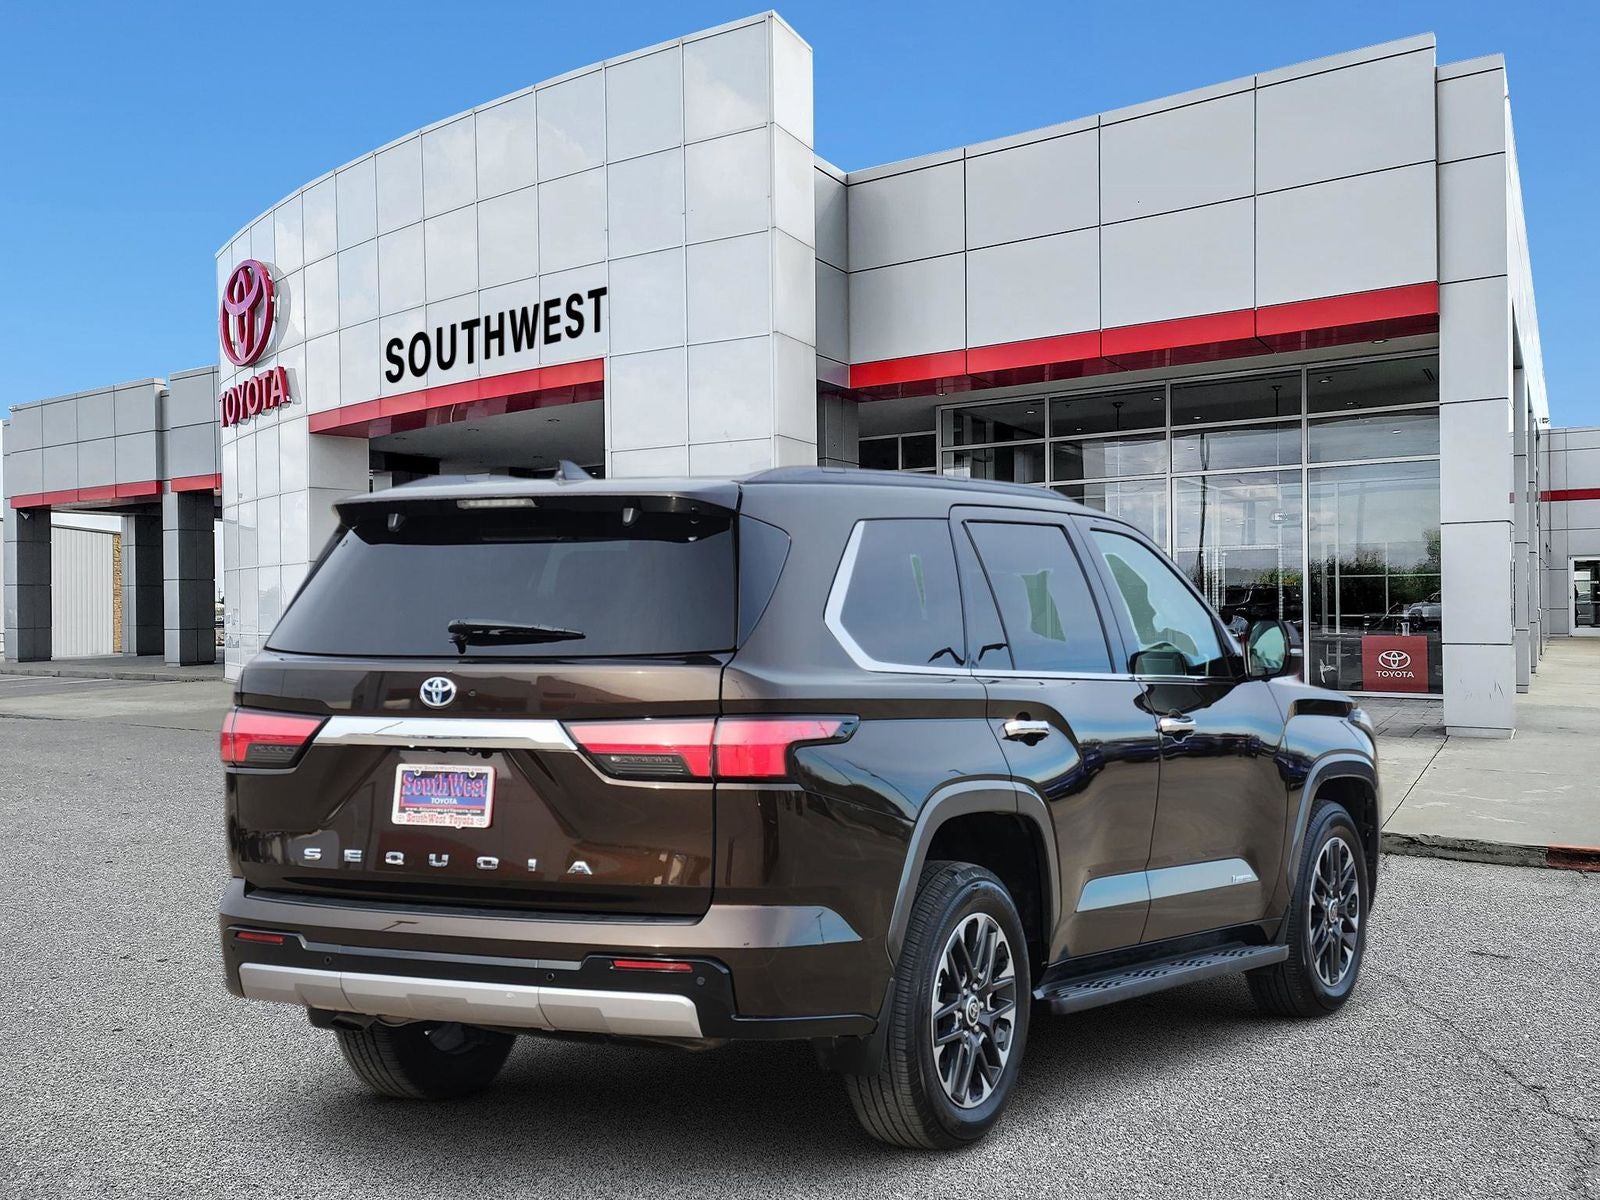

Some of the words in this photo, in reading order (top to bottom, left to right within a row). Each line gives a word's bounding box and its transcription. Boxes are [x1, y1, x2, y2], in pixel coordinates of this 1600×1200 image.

[385, 286, 608, 384] SOUTHWEST
[218, 366, 292, 428] TOYOTA
[1376, 670, 1415, 678] TOYOTA
[431, 797, 458, 805] TOYOTA
[449, 815, 474, 826] Toyota
[303, 848, 593, 875] SEQUOIA
